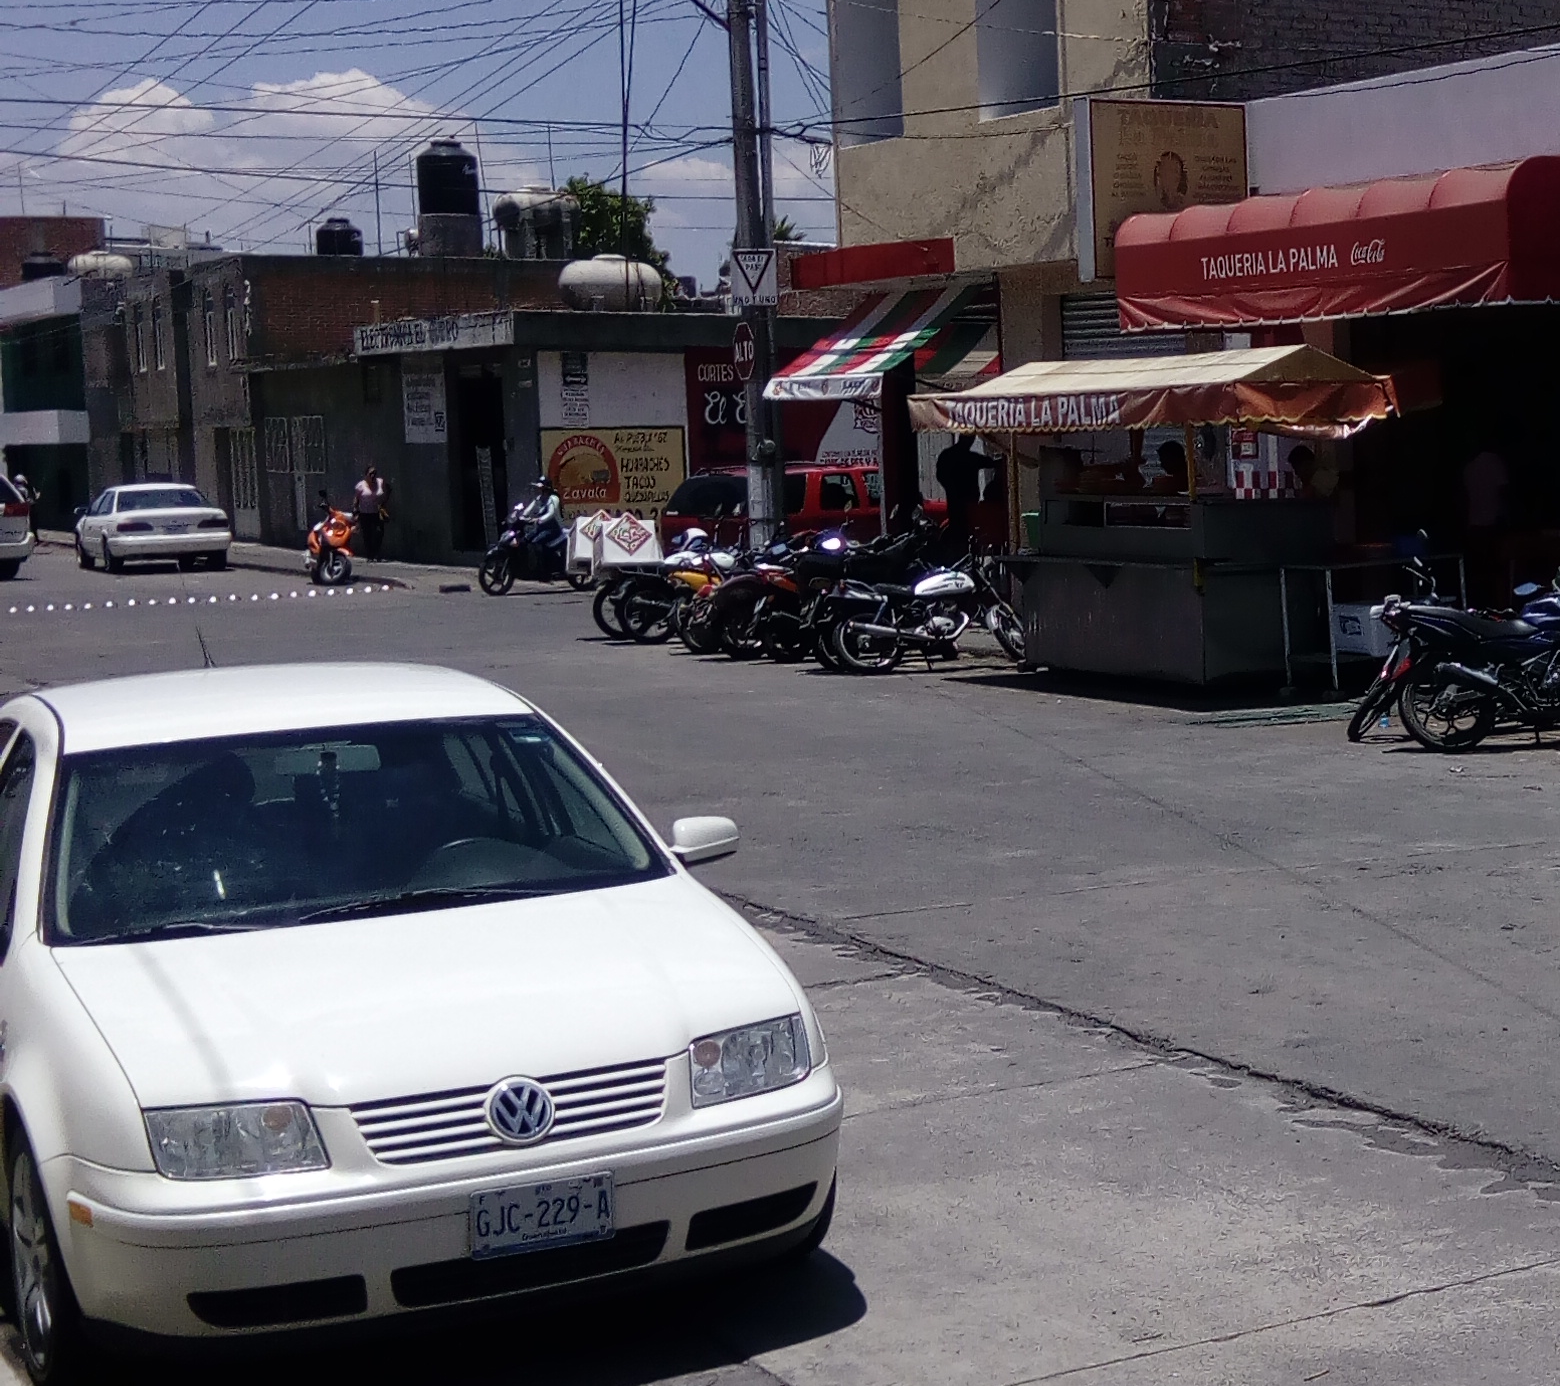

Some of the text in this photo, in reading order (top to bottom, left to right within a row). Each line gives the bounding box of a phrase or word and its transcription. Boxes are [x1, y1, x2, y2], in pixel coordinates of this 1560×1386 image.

[1200, 243, 1339, 280] TAQUERIA LA PALMA
[735, 340, 754, 363] ALTO
[697, 363, 735, 382] CORTES
[1031, 397, 1052, 426] LA
[1058, 394, 1121, 426] PALMA
[624, 475, 657, 490] TACOS
[476, 1189, 611, 1238] GJC-229-A
